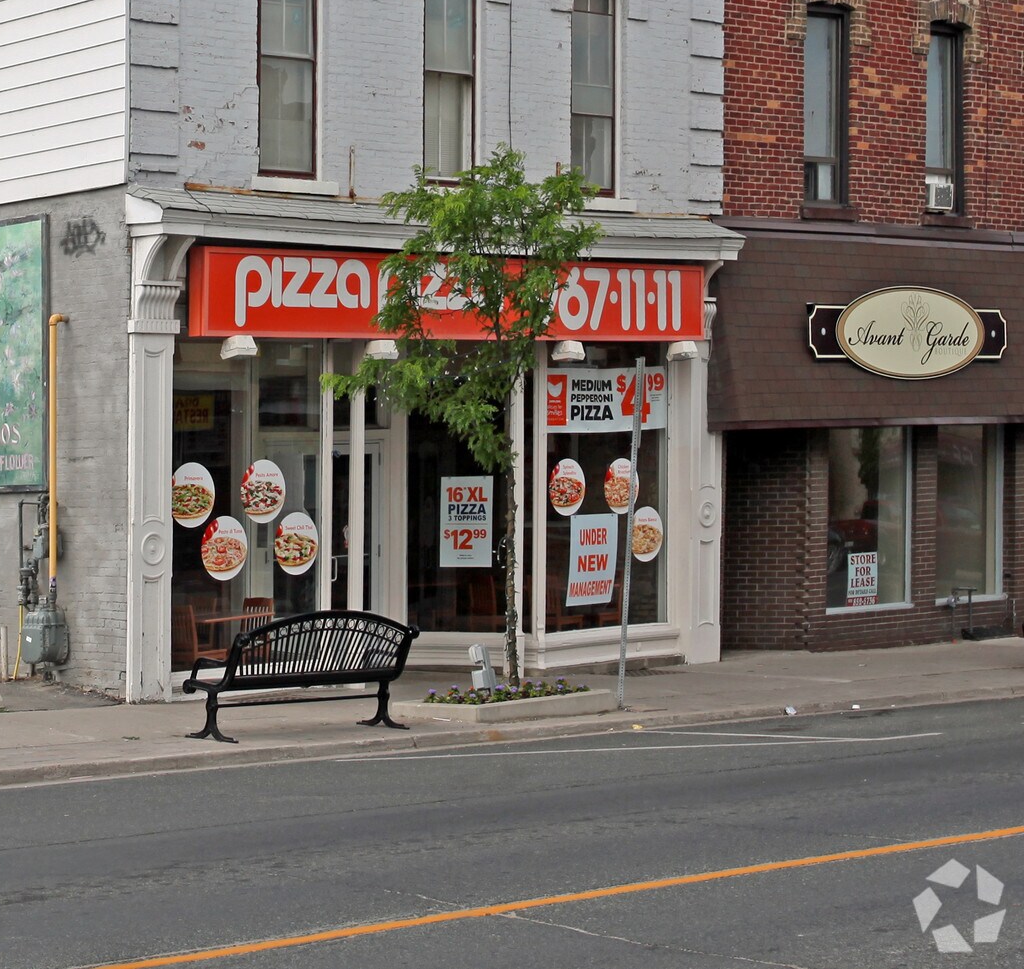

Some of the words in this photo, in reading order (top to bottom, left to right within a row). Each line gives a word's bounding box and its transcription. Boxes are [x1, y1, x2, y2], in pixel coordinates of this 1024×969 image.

[234, 255, 371, 328] pizza
[377, 260, 504, 325] pzz
[847, 319, 905, 346] Avant
[920, 320, 970, 366] Garde
[934, 347, 968, 357] BOUTIQUE
[571, 378, 613, 392] MEDIUM
[570, 393, 614, 403] PEPPERONI
[570, 404, 614, 421] PIZZA
[0, 453, 34, 471] FLOWER
[448, 504, 486, 515] PIZZA
[579, 527, 608, 546] UNDER
[577, 554, 609, 573] NEW
[850, 554, 876, 565] STORE
[855, 566, 871, 577] FOR
[569, 579, 613, 598] MANAGEMENT
[850, 577, 875, 588] LEASE
